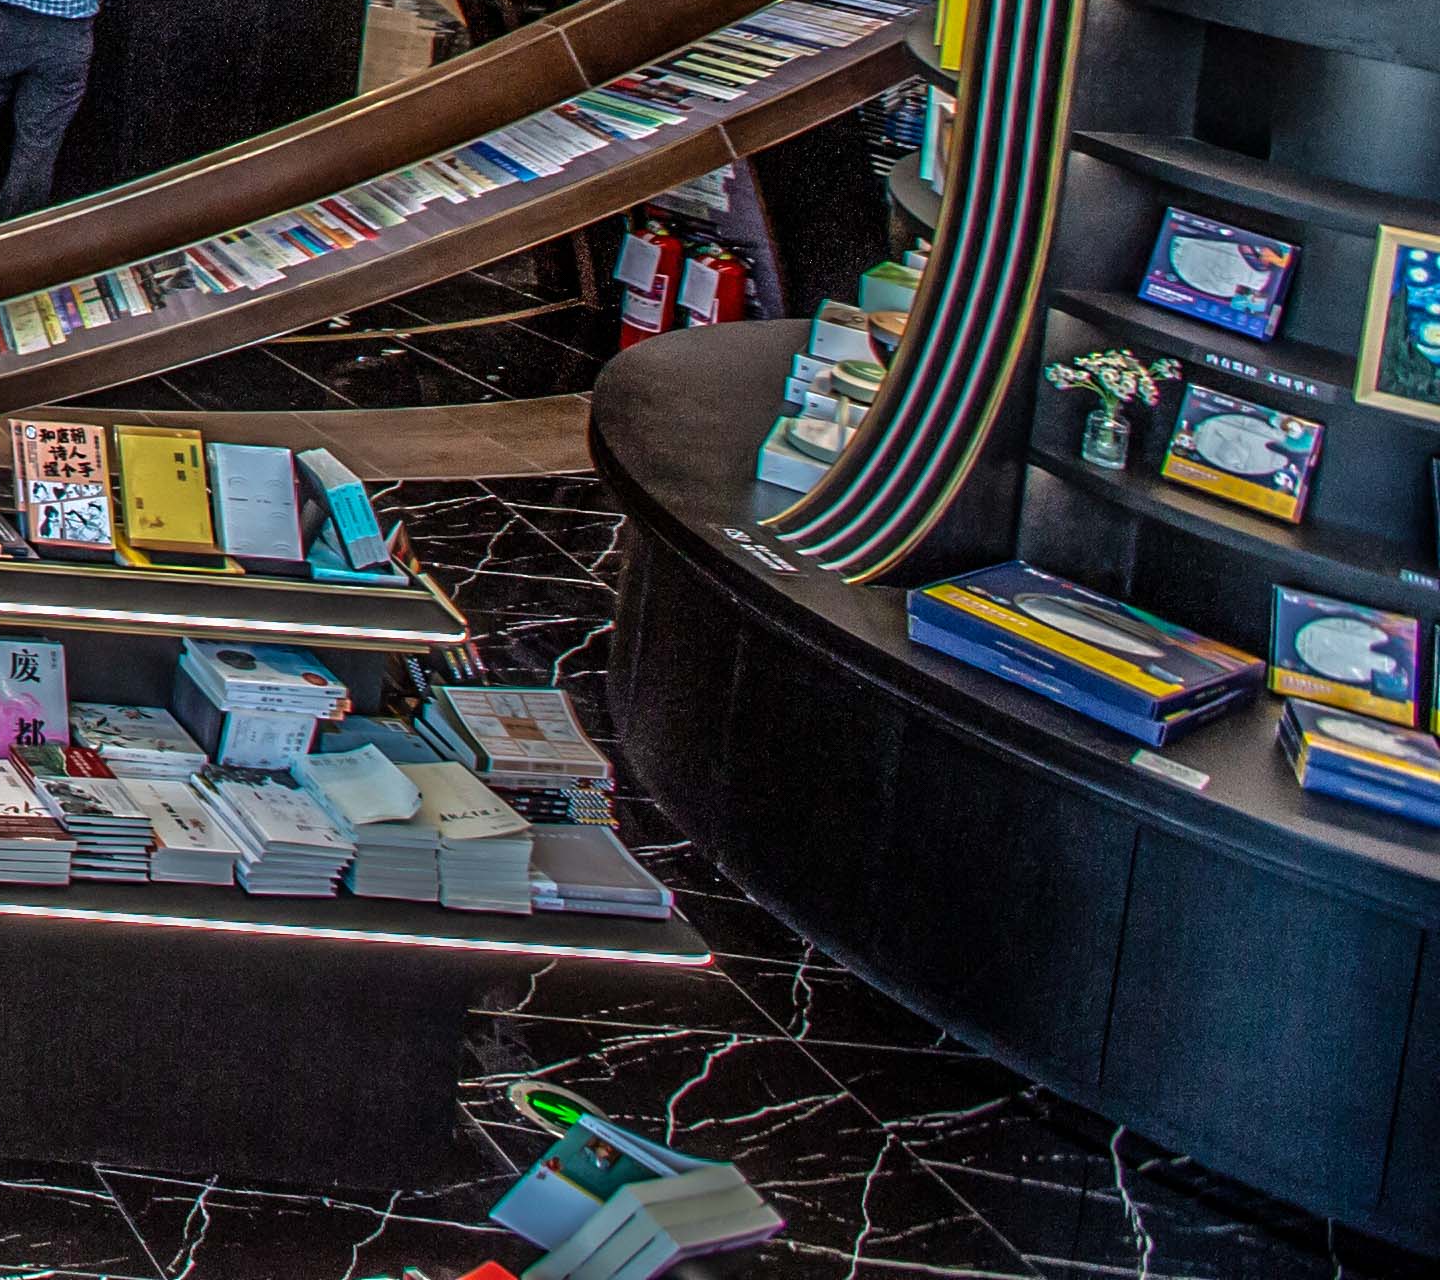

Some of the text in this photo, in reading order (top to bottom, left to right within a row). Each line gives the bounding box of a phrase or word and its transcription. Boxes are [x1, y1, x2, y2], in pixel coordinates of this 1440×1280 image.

[38, 426, 87, 445] 和唐朝
[53, 444, 87, 461] 诗人
[42, 461, 95, 479] 握个手
[9, 647, 46, 747] 废都
